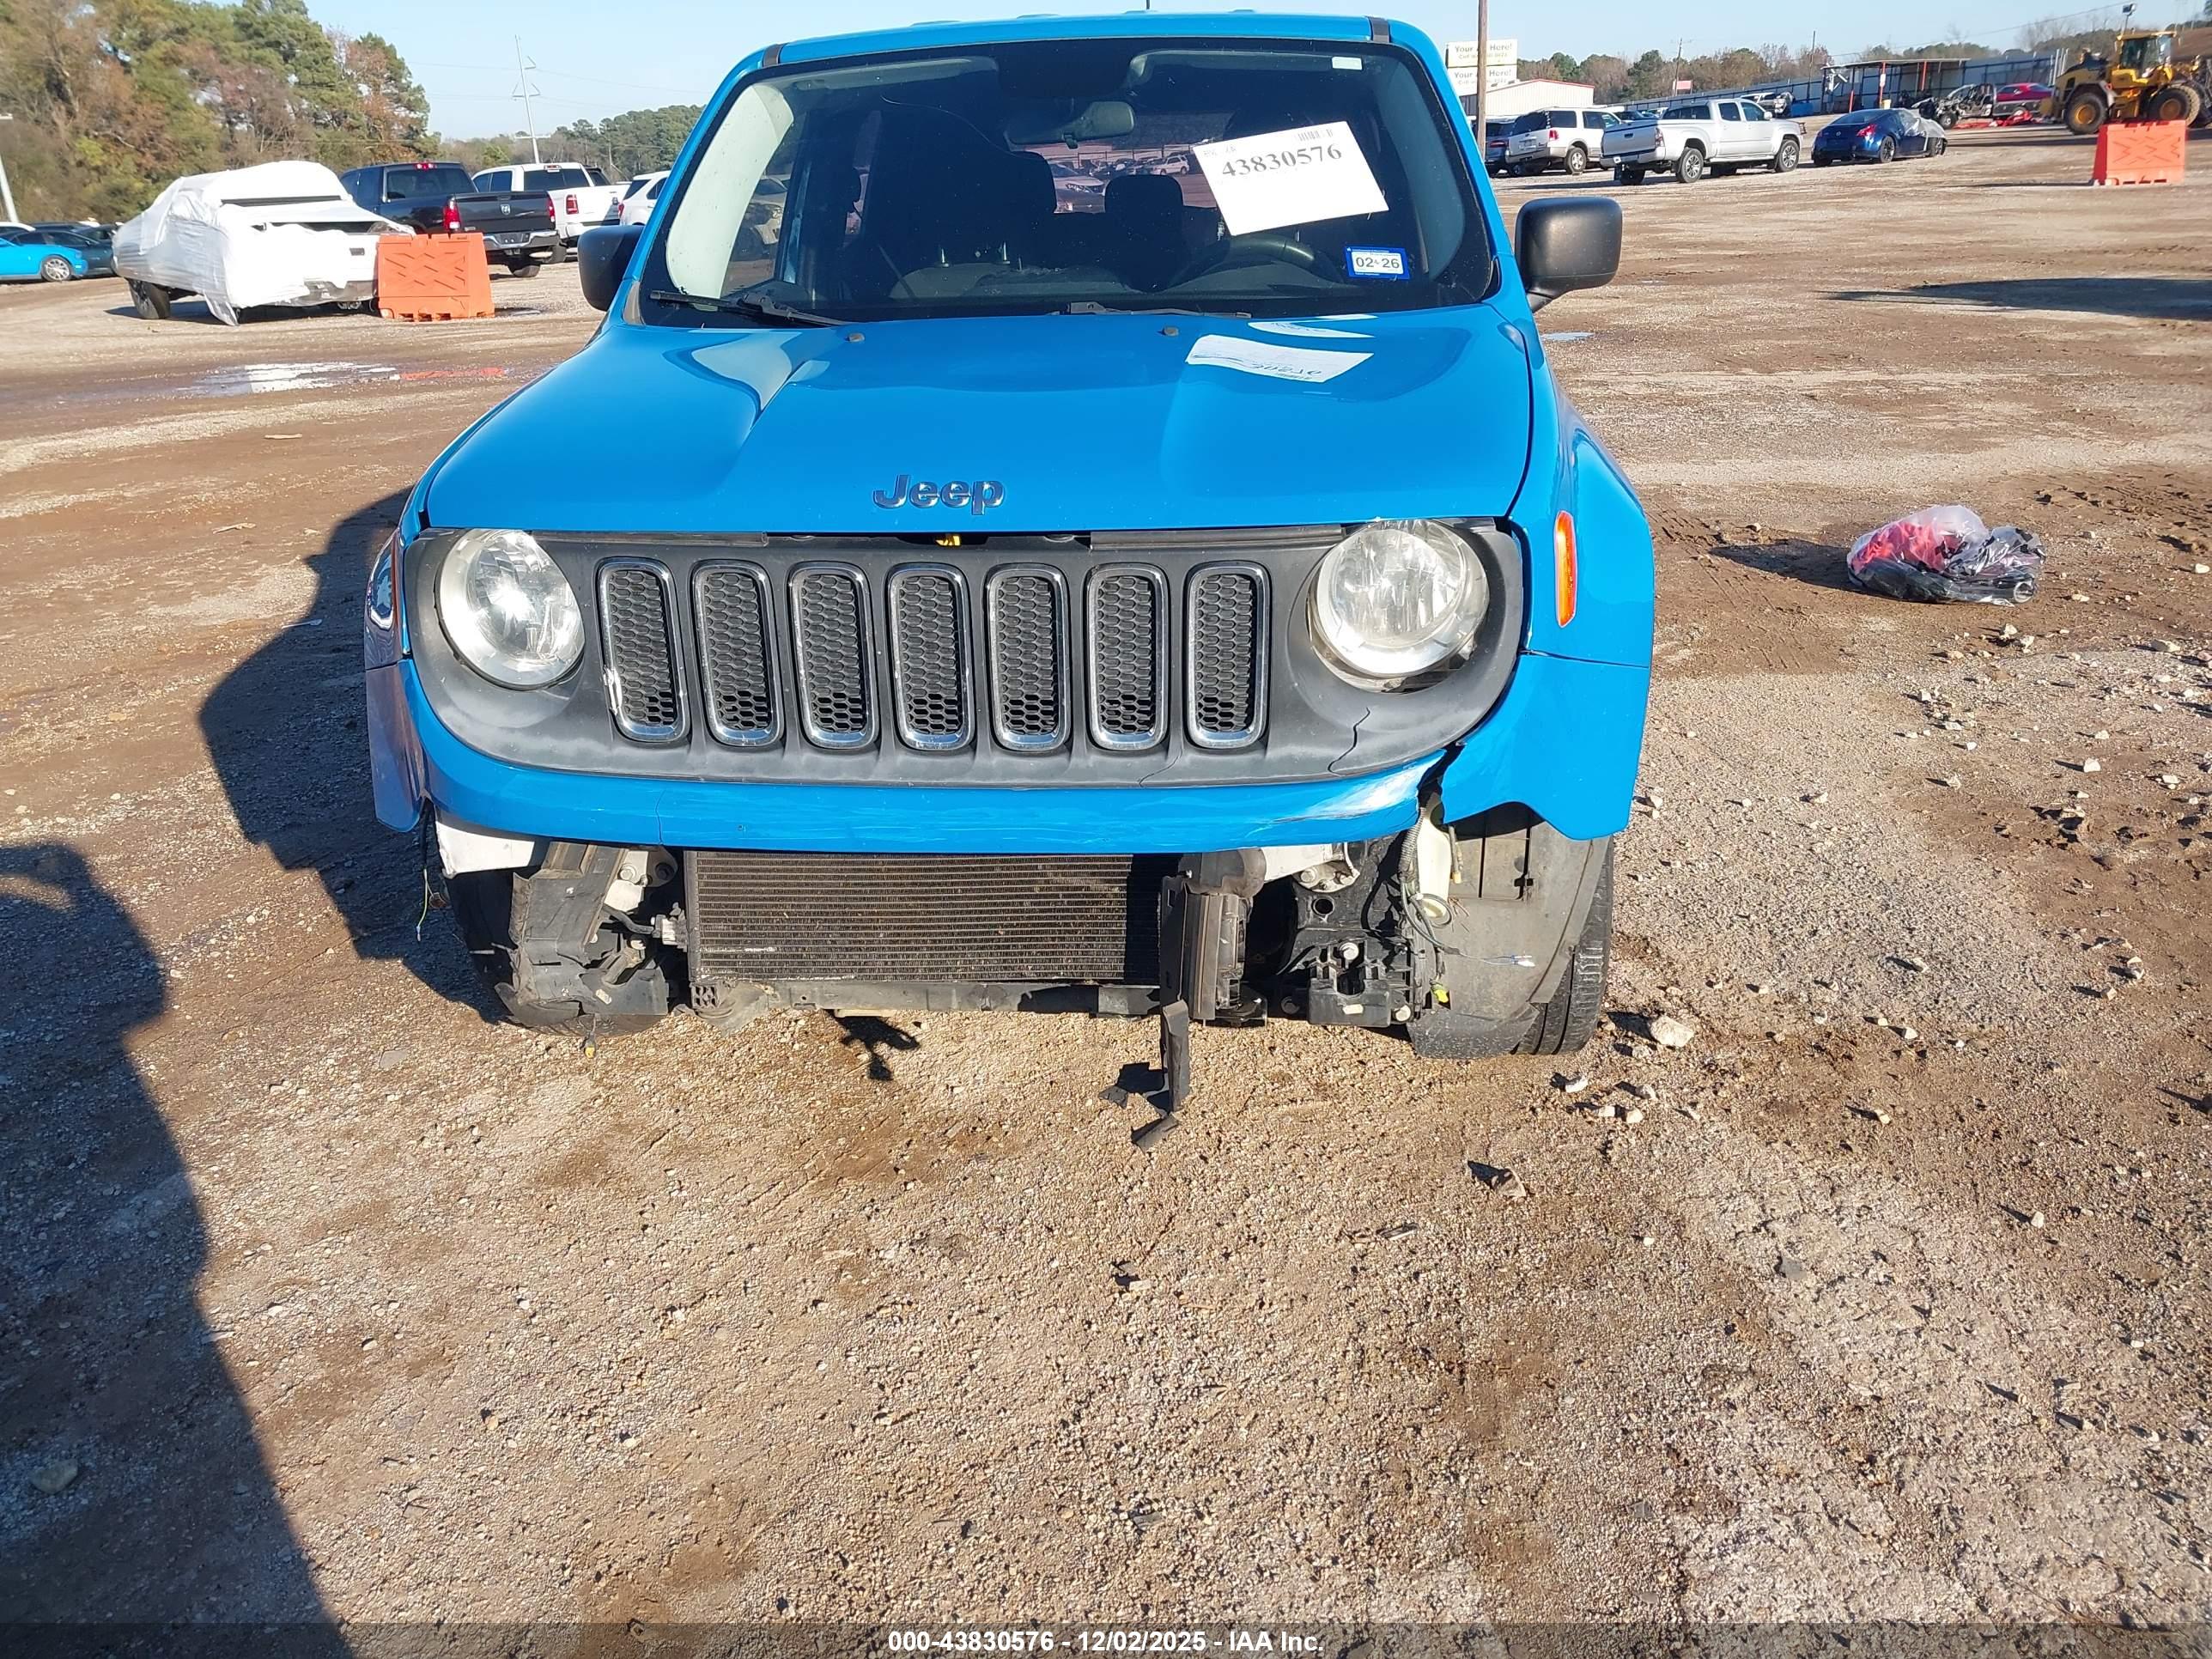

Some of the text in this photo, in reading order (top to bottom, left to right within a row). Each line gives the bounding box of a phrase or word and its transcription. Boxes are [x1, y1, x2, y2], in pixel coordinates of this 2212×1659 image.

[1221, 143, 1343, 177] 43830576
[1355, 257, 1401, 269] 02 26
[872, 474, 1006, 516] Jeep
